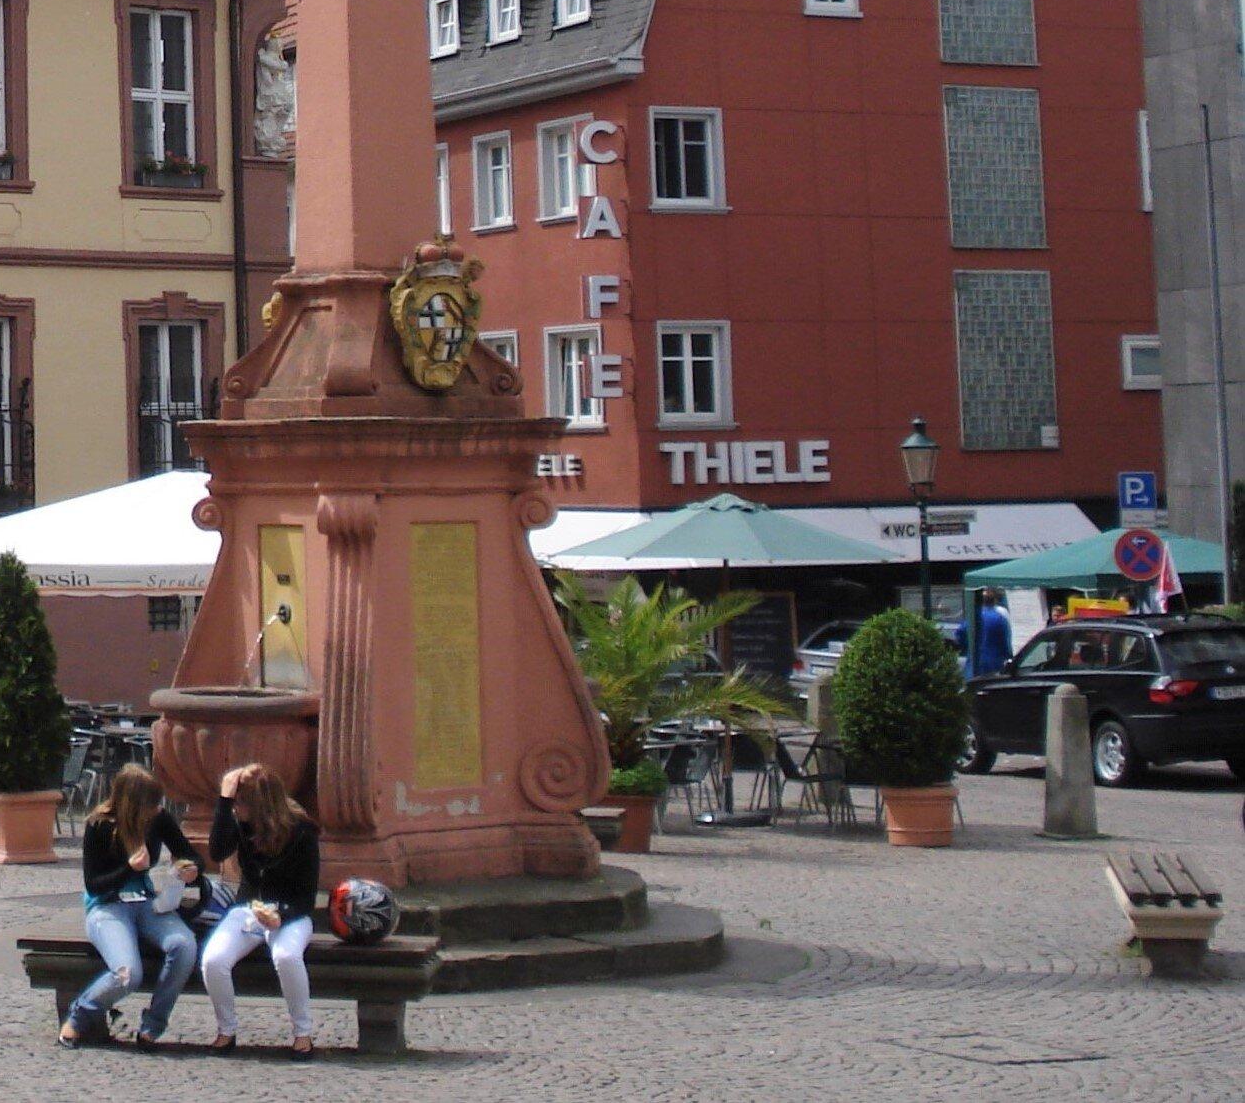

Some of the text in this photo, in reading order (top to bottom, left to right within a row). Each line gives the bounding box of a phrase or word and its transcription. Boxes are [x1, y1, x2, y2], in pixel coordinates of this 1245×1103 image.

[580, 119, 624, 397] CAFE
[537, 453, 583, 477] ELE
[659, 440, 832, 485] THIELE
[1125, 477, 1145, 505] P
[893, 524, 915, 537] WC
[1005, 541, 1073, 553] THIE
[32, 570, 205, 589] assia Sprude
